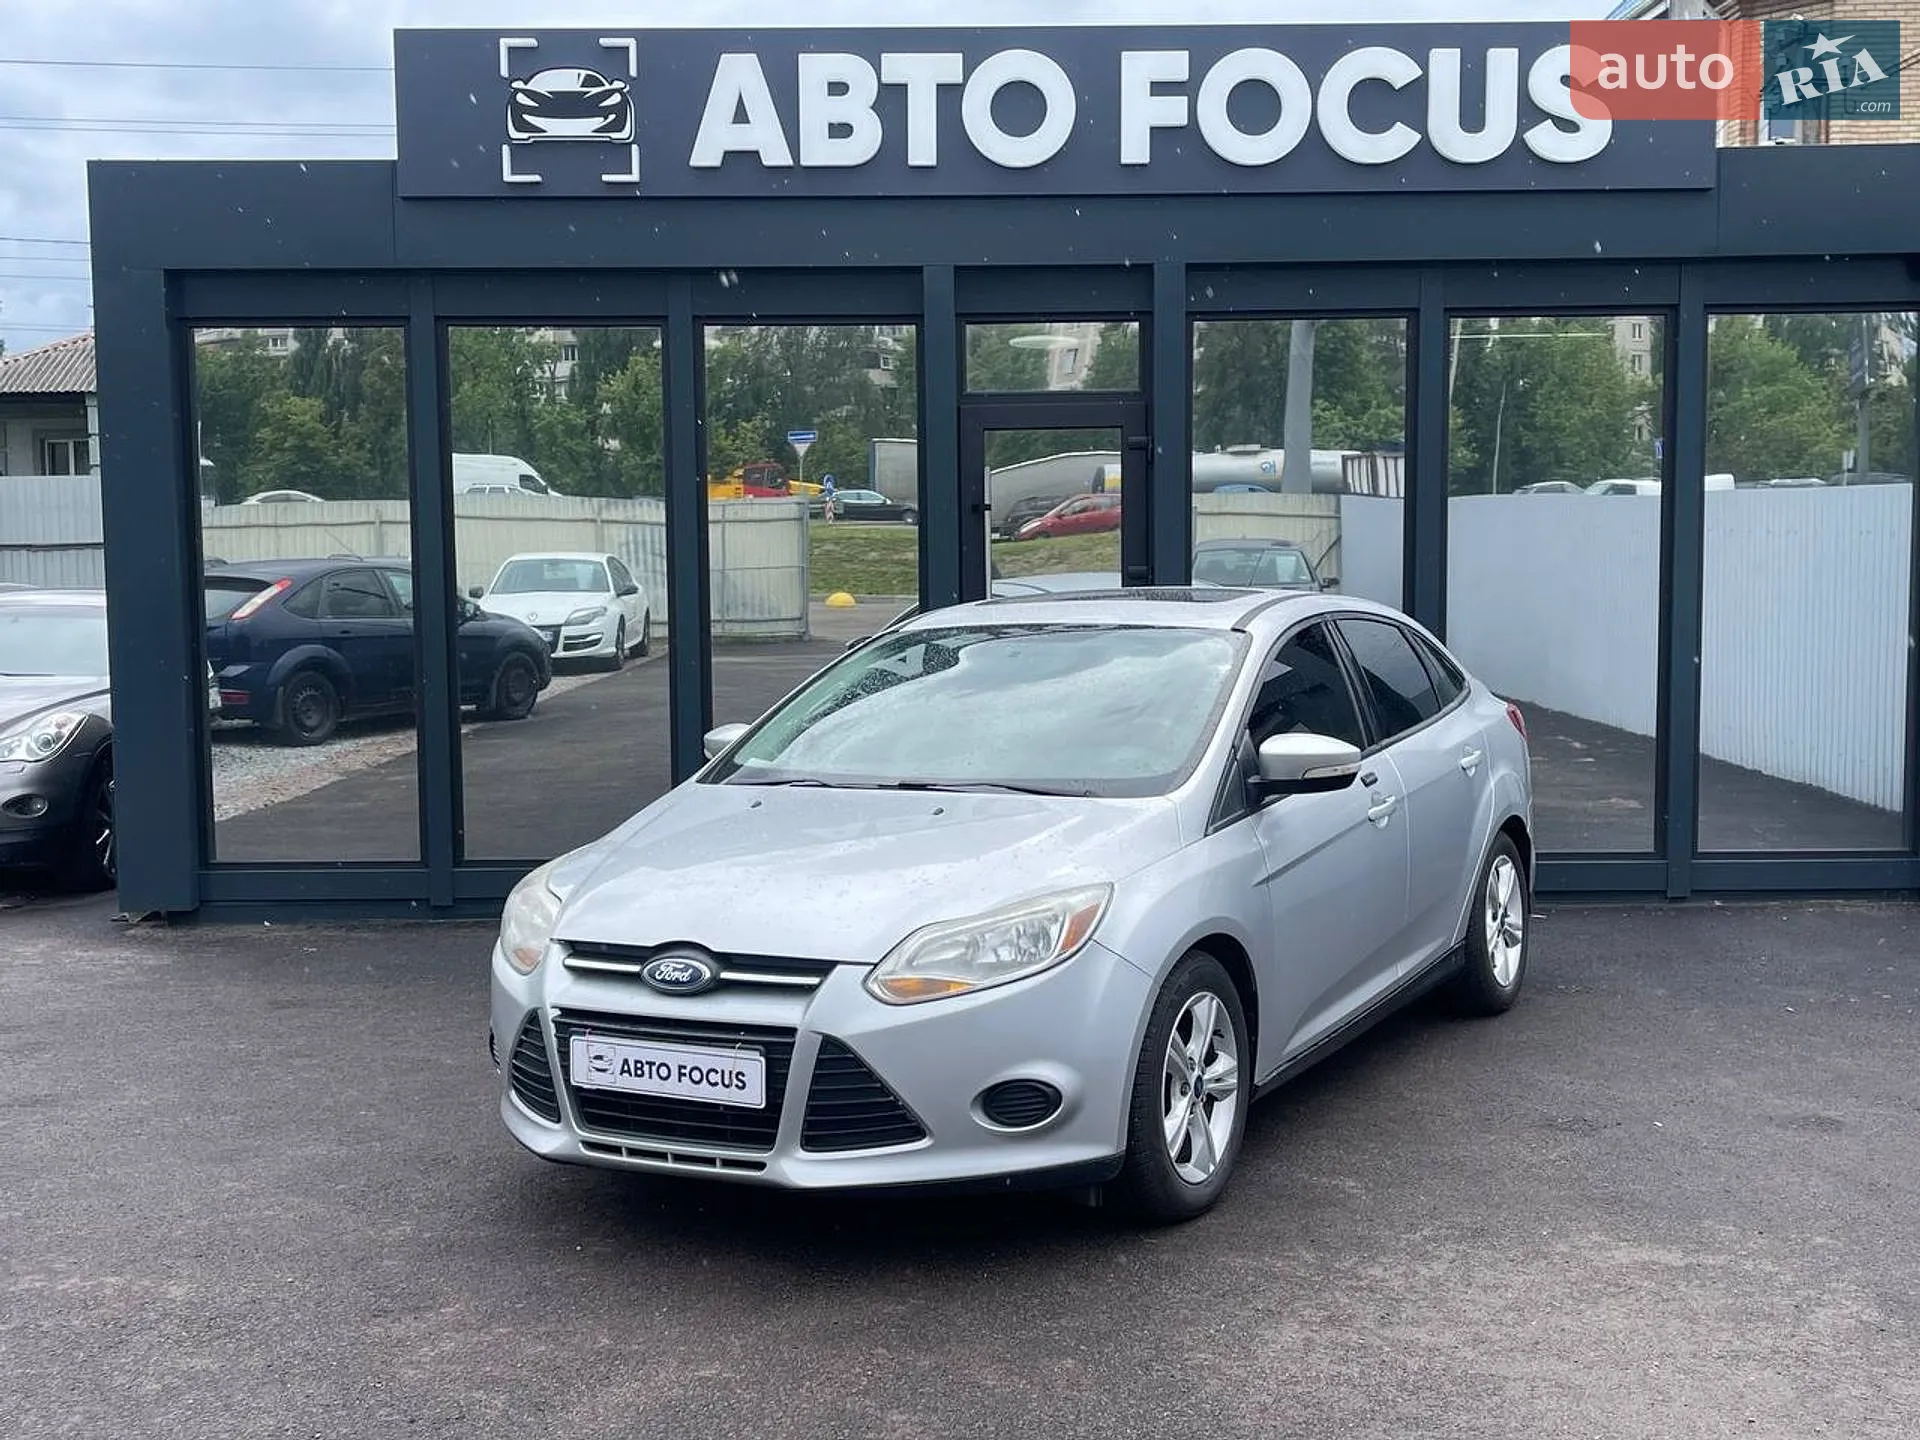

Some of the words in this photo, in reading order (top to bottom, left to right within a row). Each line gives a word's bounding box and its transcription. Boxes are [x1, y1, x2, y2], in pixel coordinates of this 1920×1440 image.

[689, 48, 1077, 168] АВТО
[1120, 45, 1613, 166] FOCUS
[655, 962, 693, 981] Ford
[619, 1058, 671, 1081] АВТО
[677, 1064, 747, 1091] FOCUS
